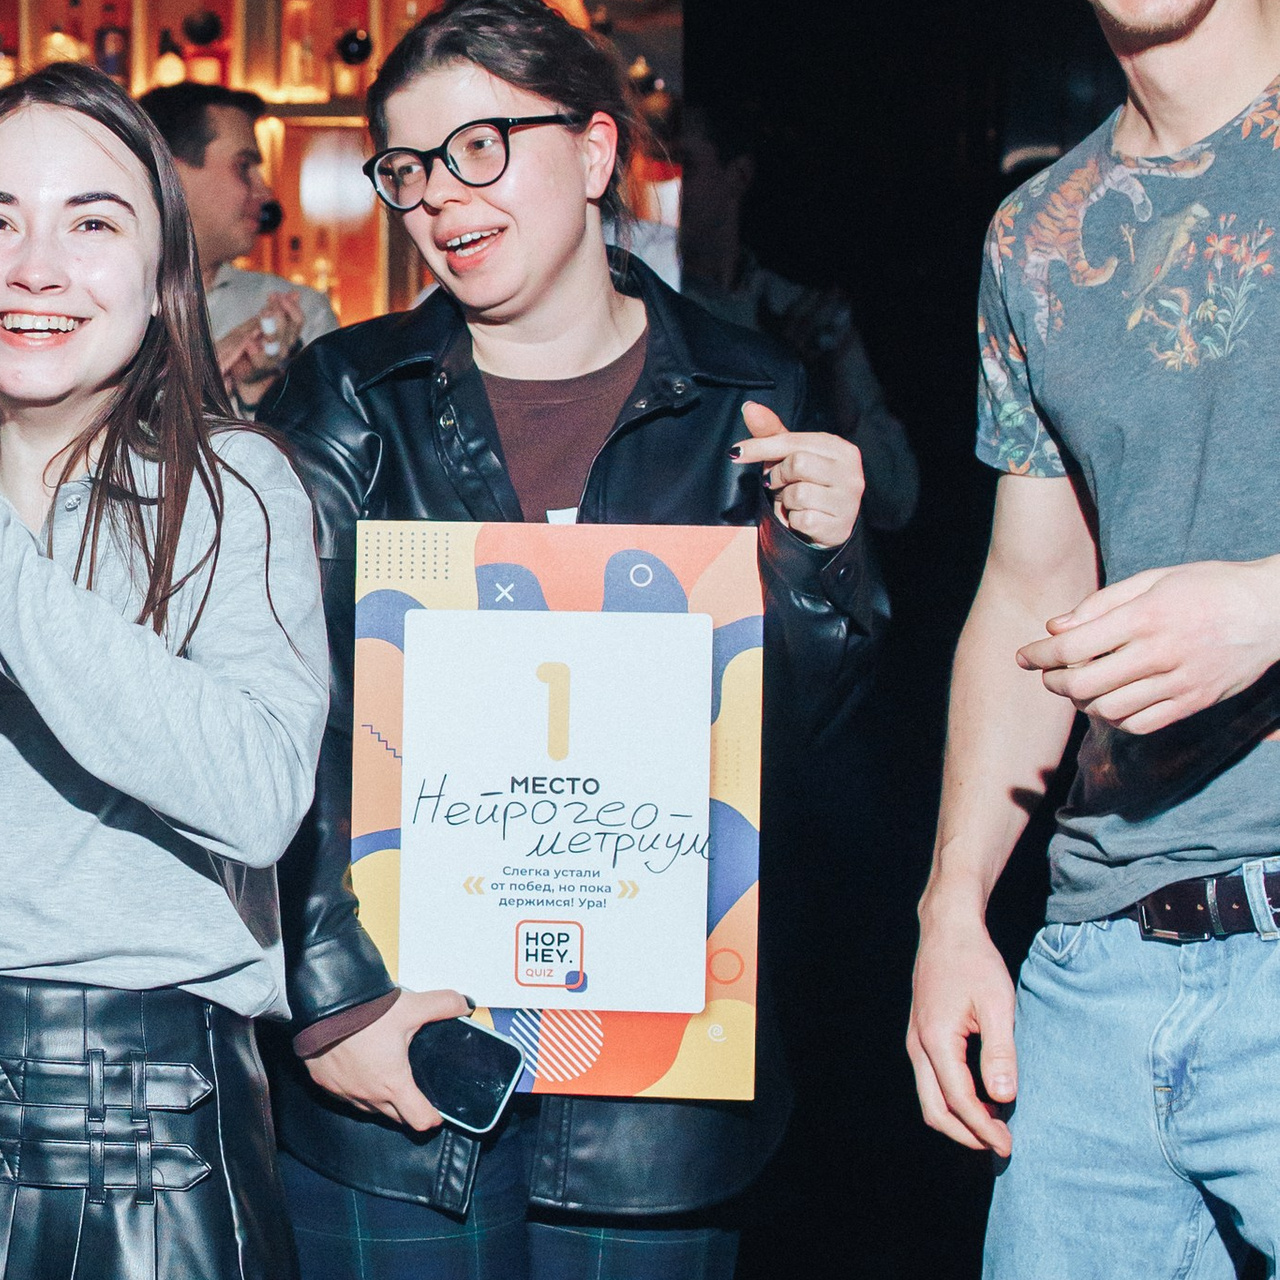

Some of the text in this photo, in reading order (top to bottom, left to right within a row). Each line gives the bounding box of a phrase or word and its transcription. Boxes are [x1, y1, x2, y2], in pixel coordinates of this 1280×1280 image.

[536, 662, 570, 761] 1
[510, 776, 600, 795] МЕСТО
[525, 830, 715, 874] метриум
[502, 866, 601, 879] Слегка устали
[490, 880, 612, 893] от побед, но пока
[498, 897, 607, 910] держимся! Ура!
[525, 932, 570, 947] HOP
[525, 948, 573, 963] HEY.
[525, 968, 554, 978] QUIZ
